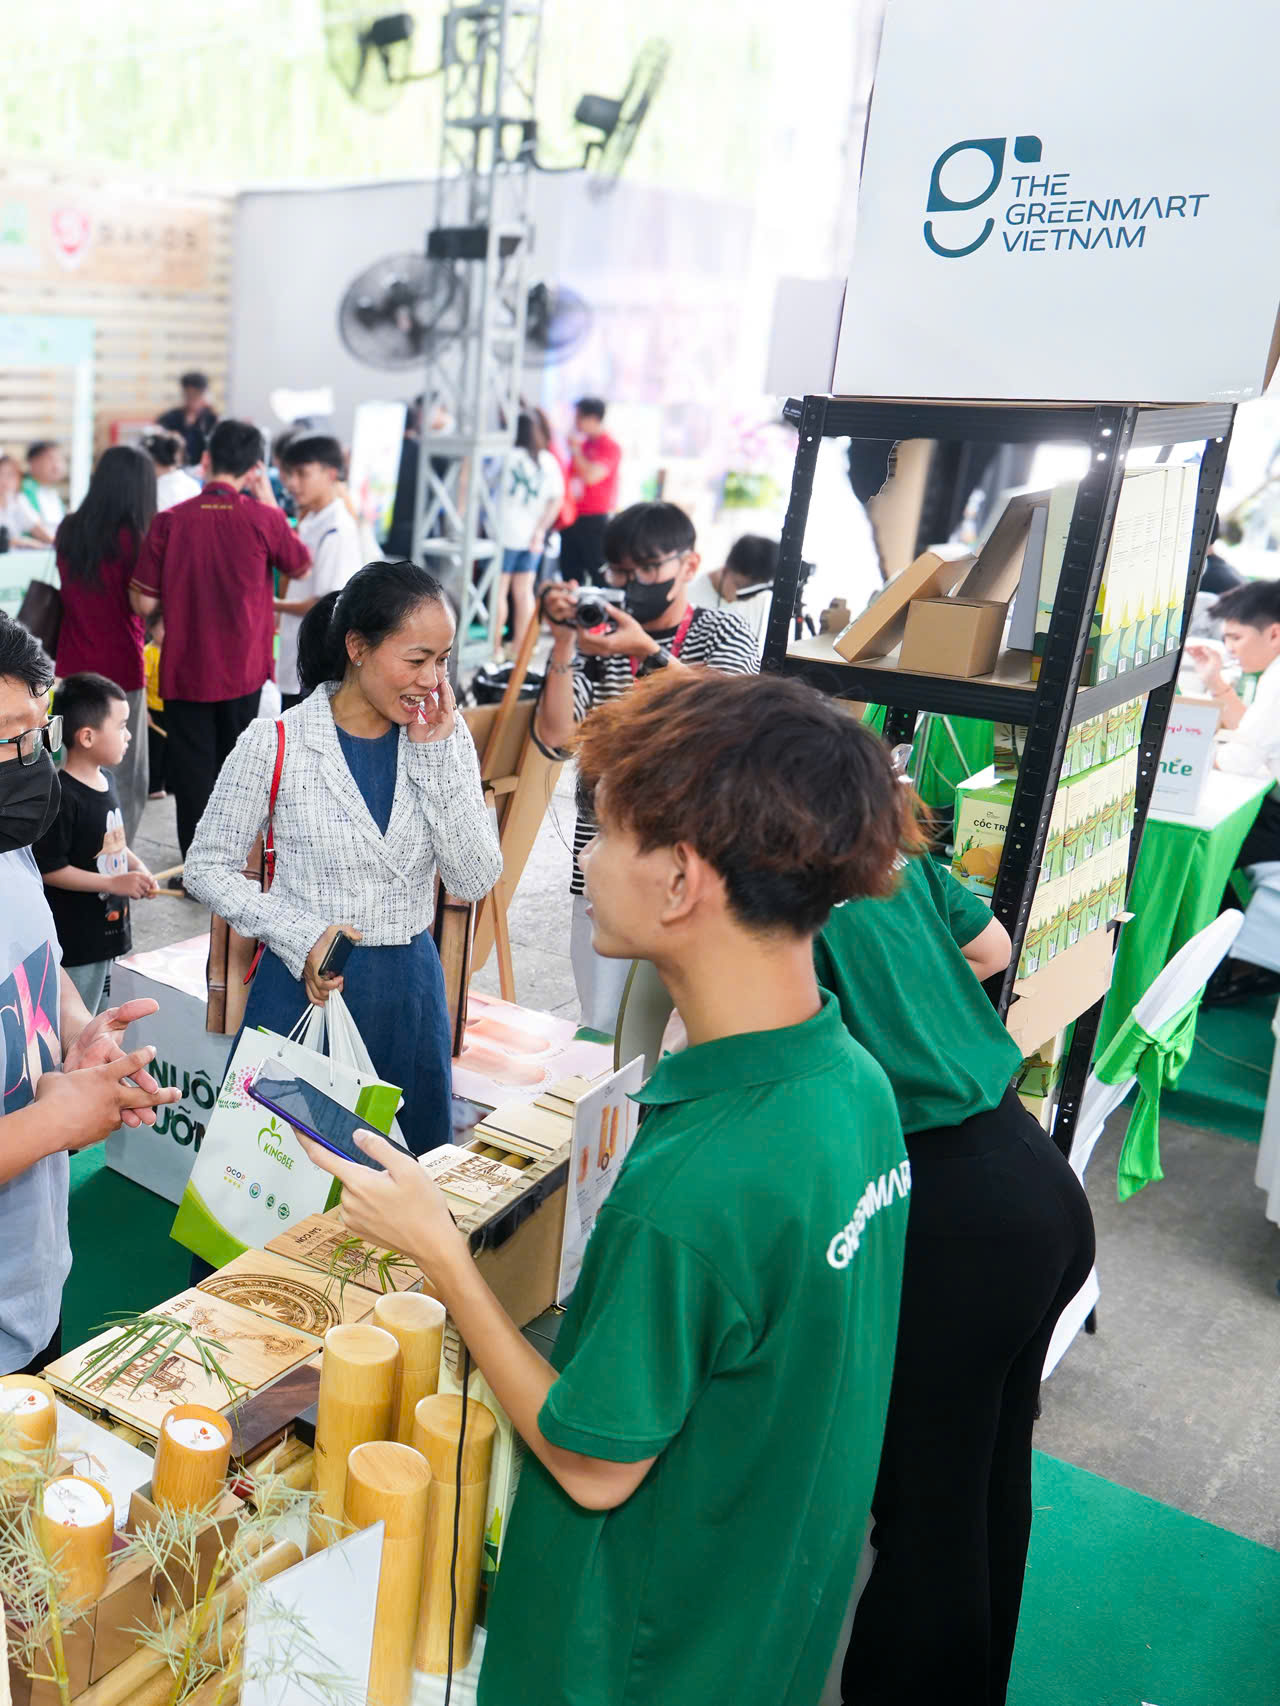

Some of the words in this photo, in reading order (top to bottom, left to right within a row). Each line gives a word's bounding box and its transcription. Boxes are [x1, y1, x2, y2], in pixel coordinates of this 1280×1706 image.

[1011, 173, 1070, 198] THE
[1005, 194, 1210, 225] GREENMART
[1002, 226, 1146, 252] VIETNAM
[263, 1142, 295, 1171] KINGBEE
[225, 1165, 246, 1181] OCOP
